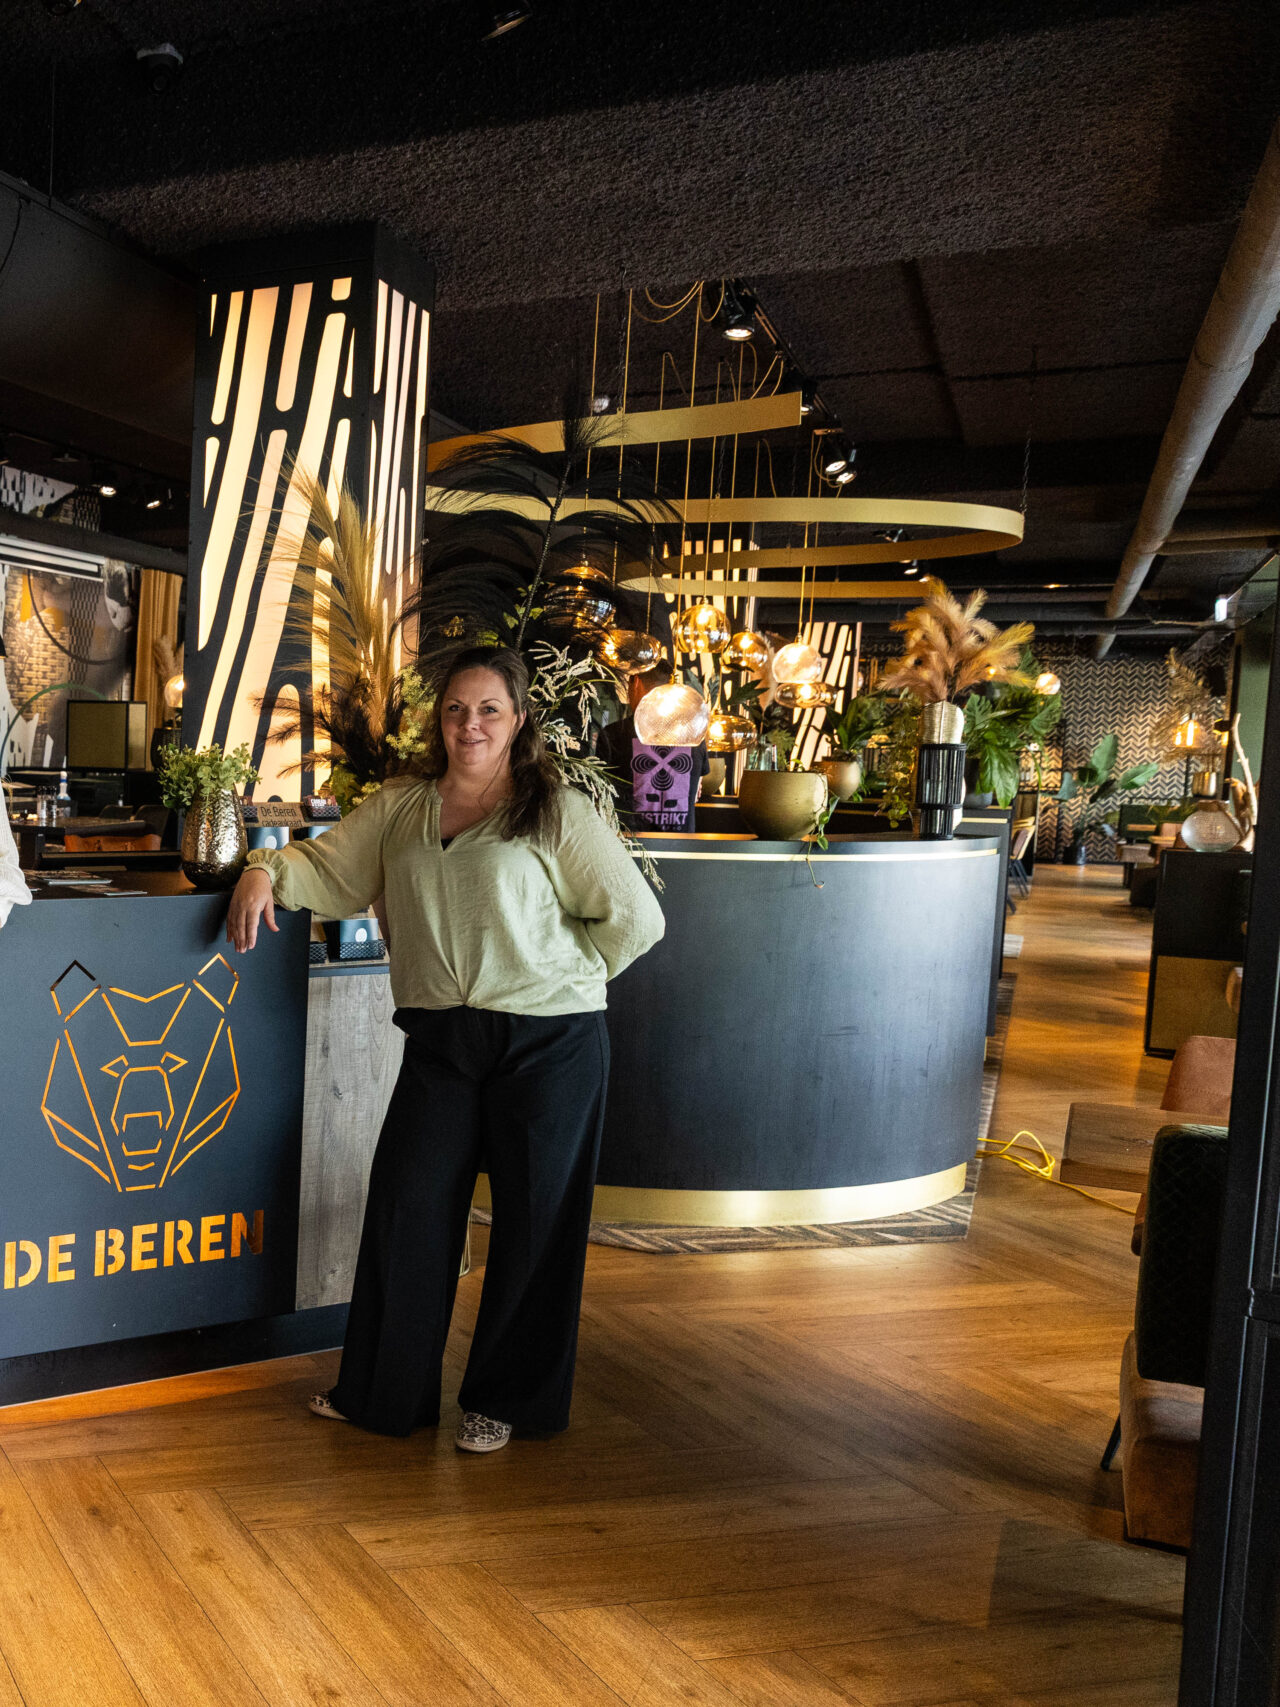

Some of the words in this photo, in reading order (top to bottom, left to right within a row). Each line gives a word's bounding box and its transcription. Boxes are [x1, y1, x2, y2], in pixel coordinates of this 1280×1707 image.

[261, 806, 272, 817] De
[273, 806, 296, 817] Beren
[4, 1233, 76, 1289] DE
[94, 1209, 264, 1276] BEREN
